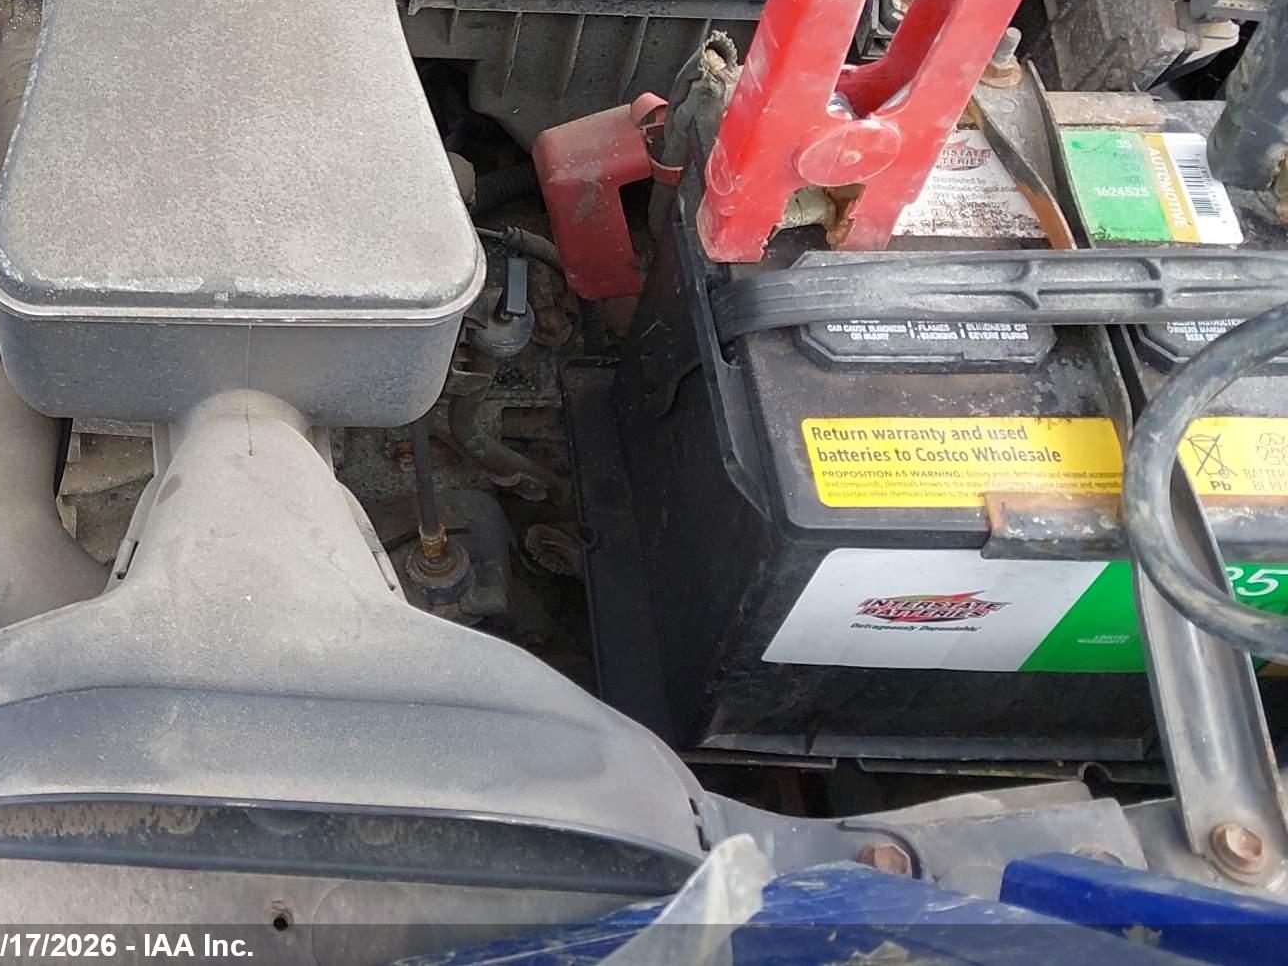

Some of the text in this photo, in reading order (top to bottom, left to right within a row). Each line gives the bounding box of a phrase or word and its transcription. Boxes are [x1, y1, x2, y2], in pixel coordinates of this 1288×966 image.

[1147, 146, 1187, 229] AUTOMOTIVE
[812, 425, 1028, 445] Return warranty and used
[816, 446, 1062, 463] batteries to Costco Wholesale
[822, 470, 893, 478] PROPOSITION
[895, 470, 908, 478] 65
[1210, 480, 1232, 491] Pb
[860, 598, 1002, 611] INTERSTATE
[859, 607, 989, 618] BATTERIES
[850, 622, 916, 632] Outrageously
